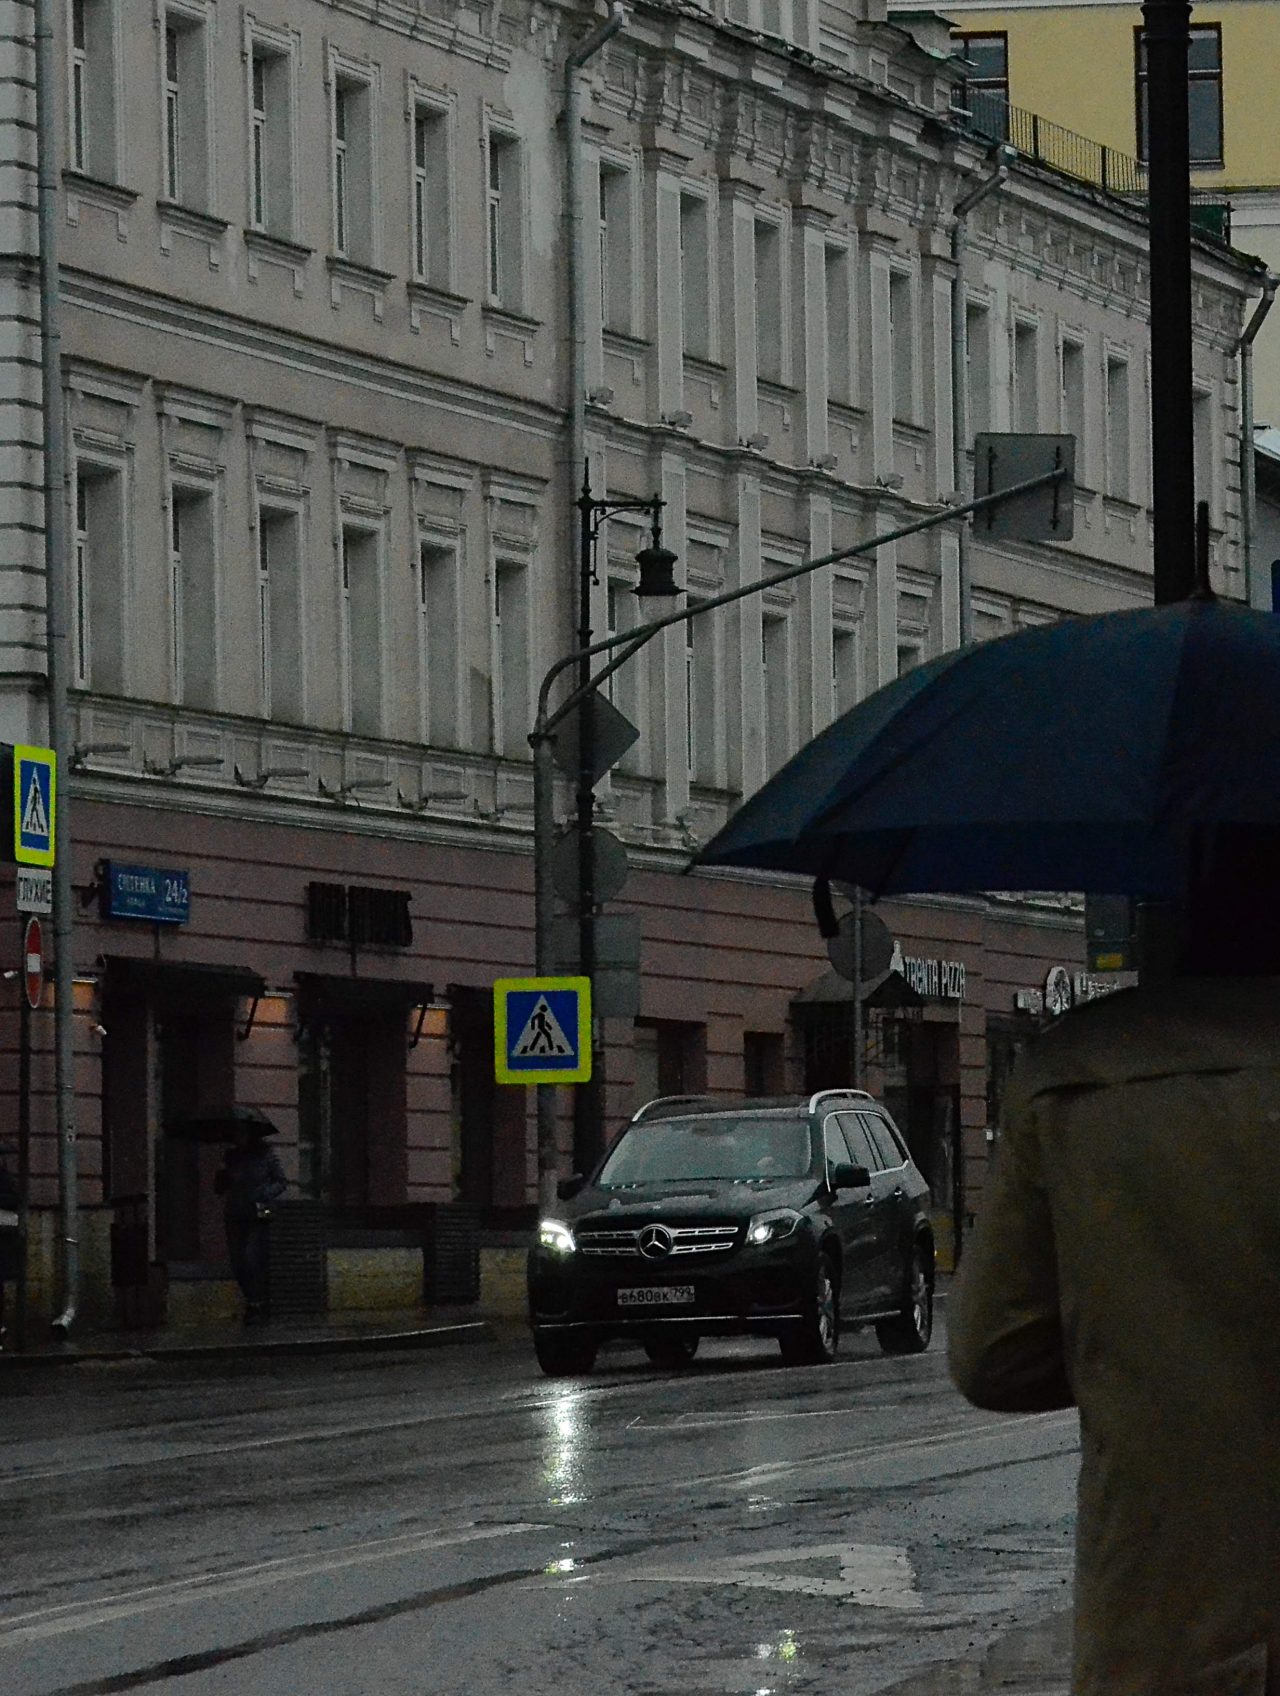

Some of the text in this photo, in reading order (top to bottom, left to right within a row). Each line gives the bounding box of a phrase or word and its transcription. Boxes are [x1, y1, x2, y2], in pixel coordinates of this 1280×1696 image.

[165, 879, 188, 904] 24/2
[904, 955, 966, 998] TRENTA PIZZA
